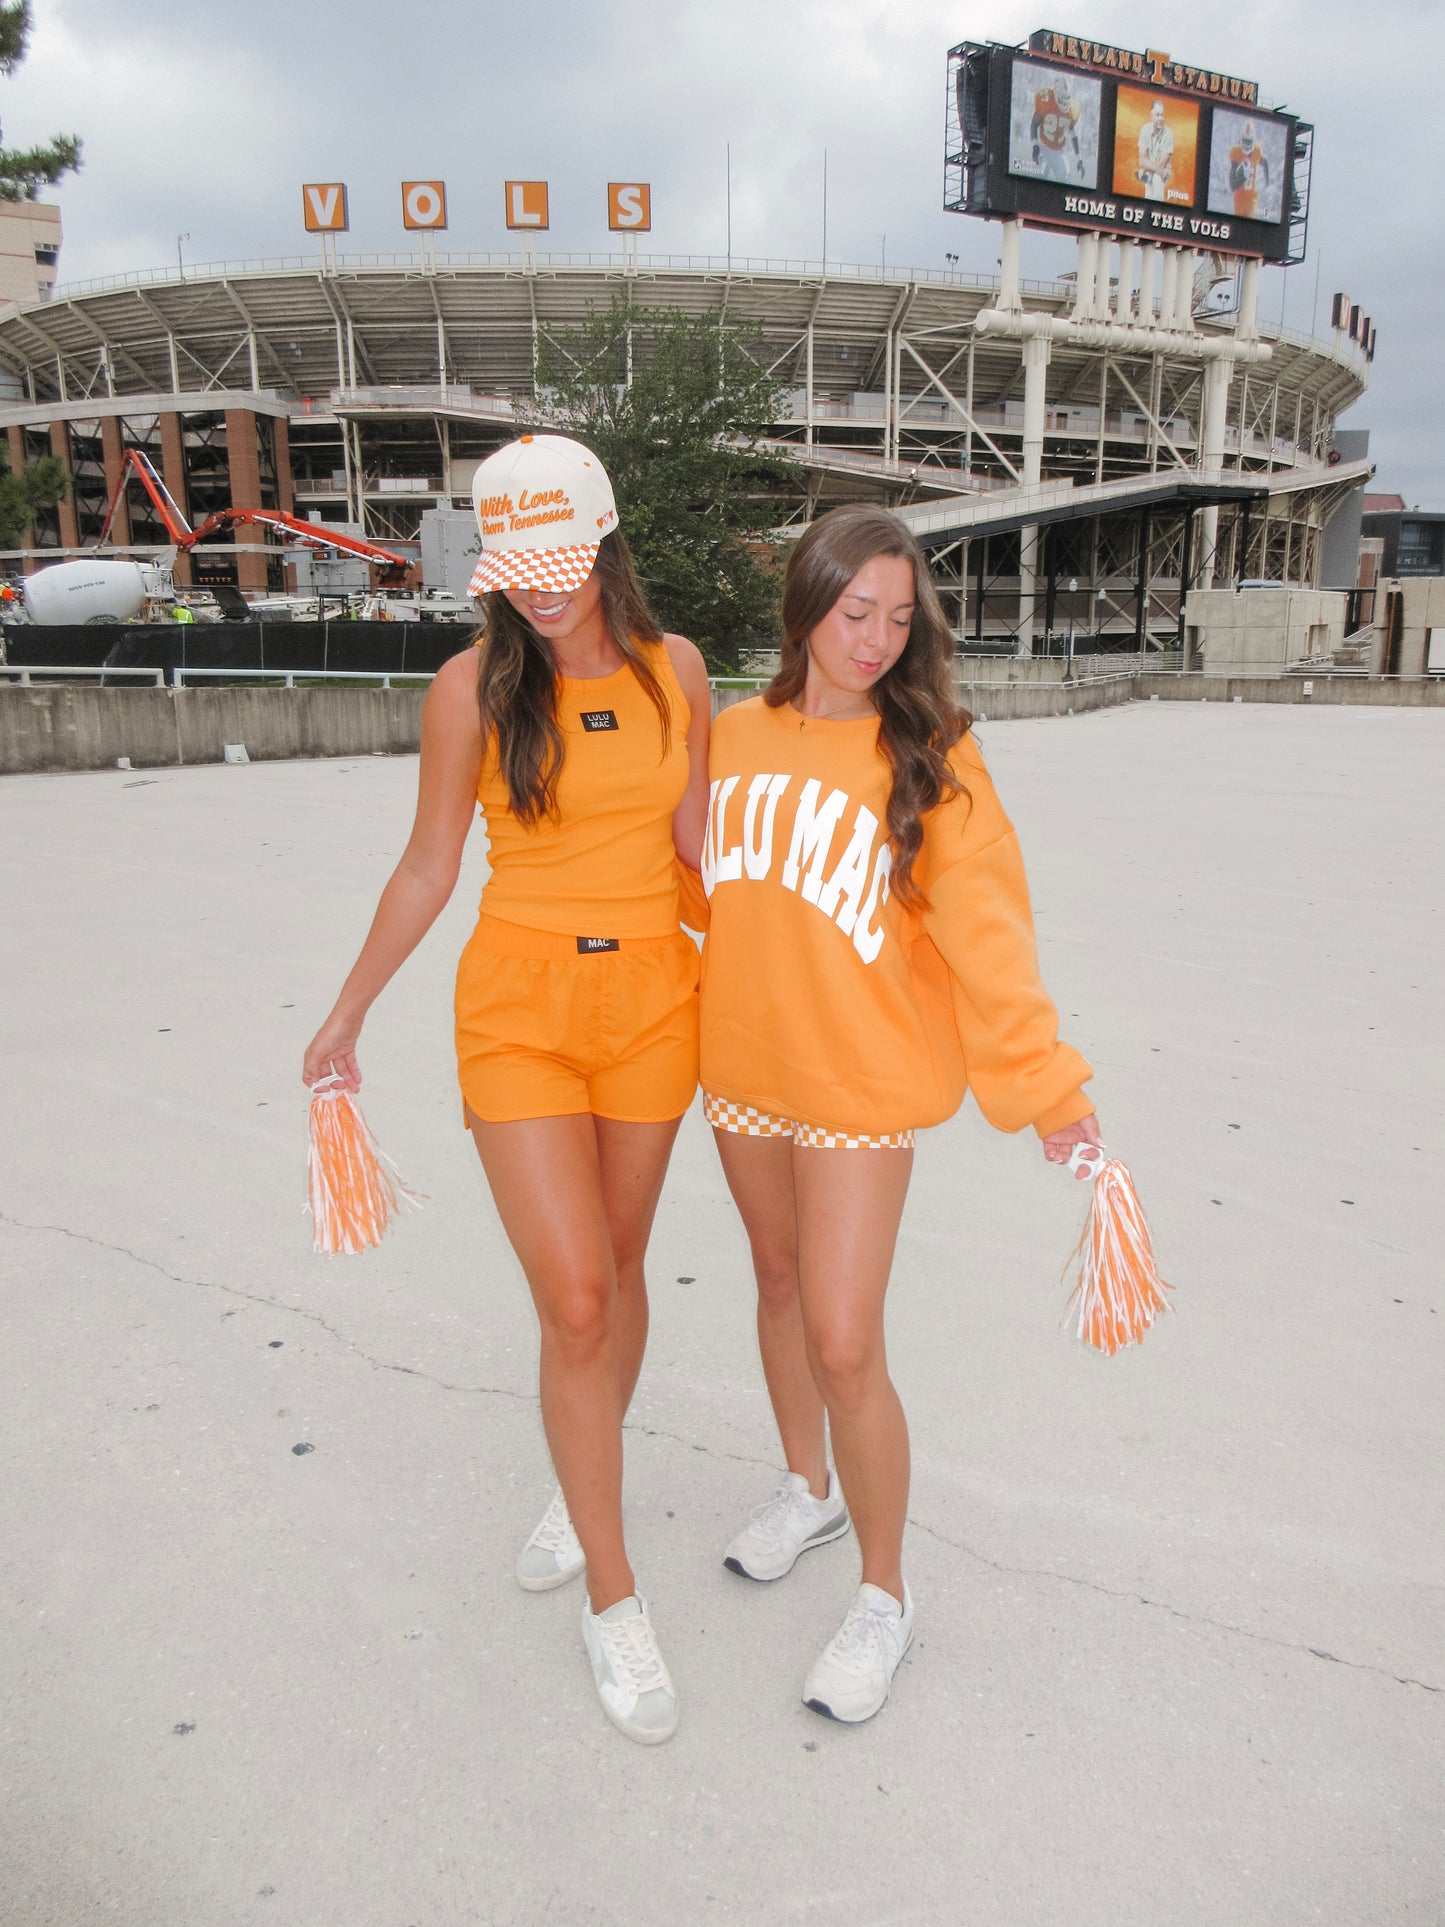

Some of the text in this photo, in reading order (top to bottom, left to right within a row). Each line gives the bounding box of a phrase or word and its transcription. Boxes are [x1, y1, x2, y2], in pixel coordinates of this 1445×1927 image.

[1052, 33, 1143, 73] NEYLAND
[1173, 64, 1257, 101] STADIUM
[1064, 196, 1230, 240] HOME OF THE VOLS
[480, 489, 569, 518] With Love,
[509, 507, 575, 531] Tennessee
[587, 713, 609, 722] LULU
[591, 720, 610, 729] MAC
[701, 774, 893, 965] ULU MAC
[588, 938, 610, 949] MAC
